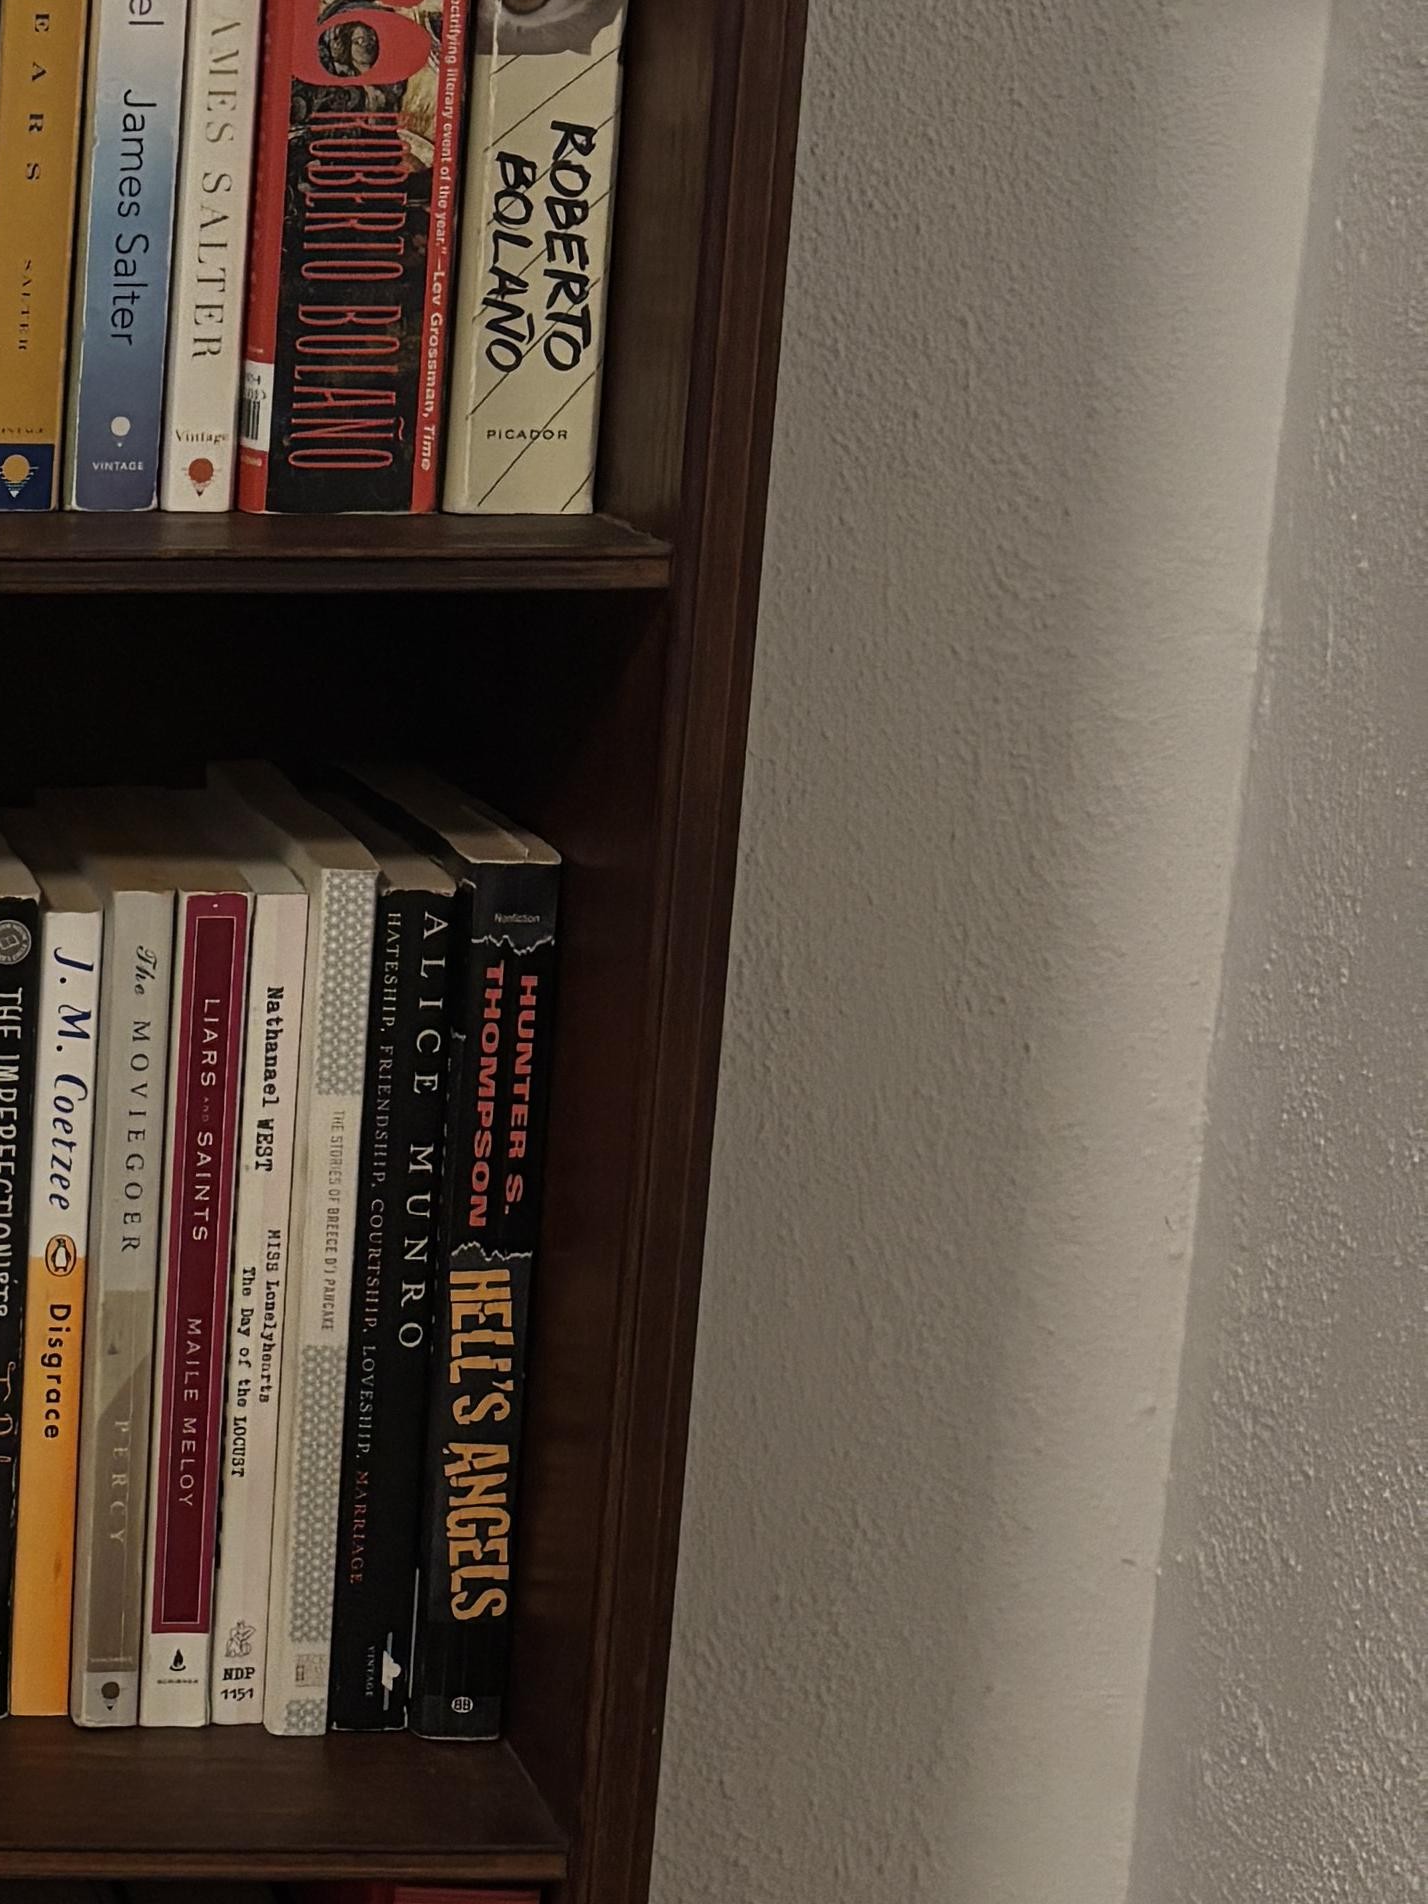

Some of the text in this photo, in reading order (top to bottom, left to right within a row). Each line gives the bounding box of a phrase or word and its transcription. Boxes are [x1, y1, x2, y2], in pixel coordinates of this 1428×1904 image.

[482, 152, 537, 372] BOLAÑO
[543, 120, 597, 371] ROBERTO
[486, 429, 568, 439] PICADOR
[469, 960, 504, 1227] THOMPSON
[504, 975, 539, 1215] HUNTER S.
[42, 1304, 71, 1439] Disgrace
[177, 1318, 202, 1507] MAILE MELOY
[442, 1268, 516, 1621] HELL'S ANGELS
[223, 1668, 255, 1680] NDP
